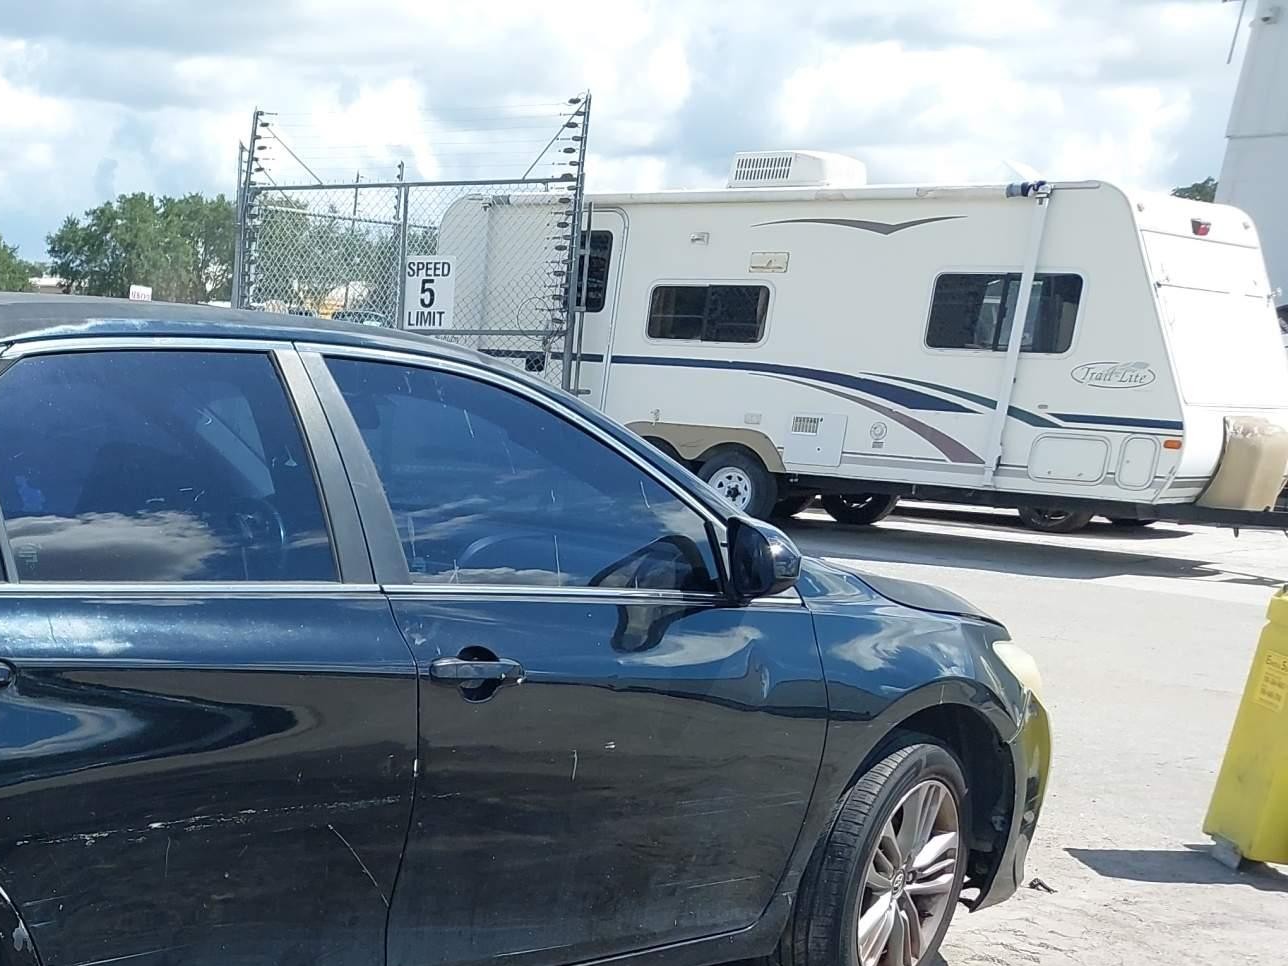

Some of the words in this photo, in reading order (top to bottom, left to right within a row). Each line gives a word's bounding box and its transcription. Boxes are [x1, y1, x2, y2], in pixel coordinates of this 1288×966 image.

[407, 261, 451, 277] SPEED
[419, 278, 435, 308] 5
[407, 310, 445, 327] LIMIT
